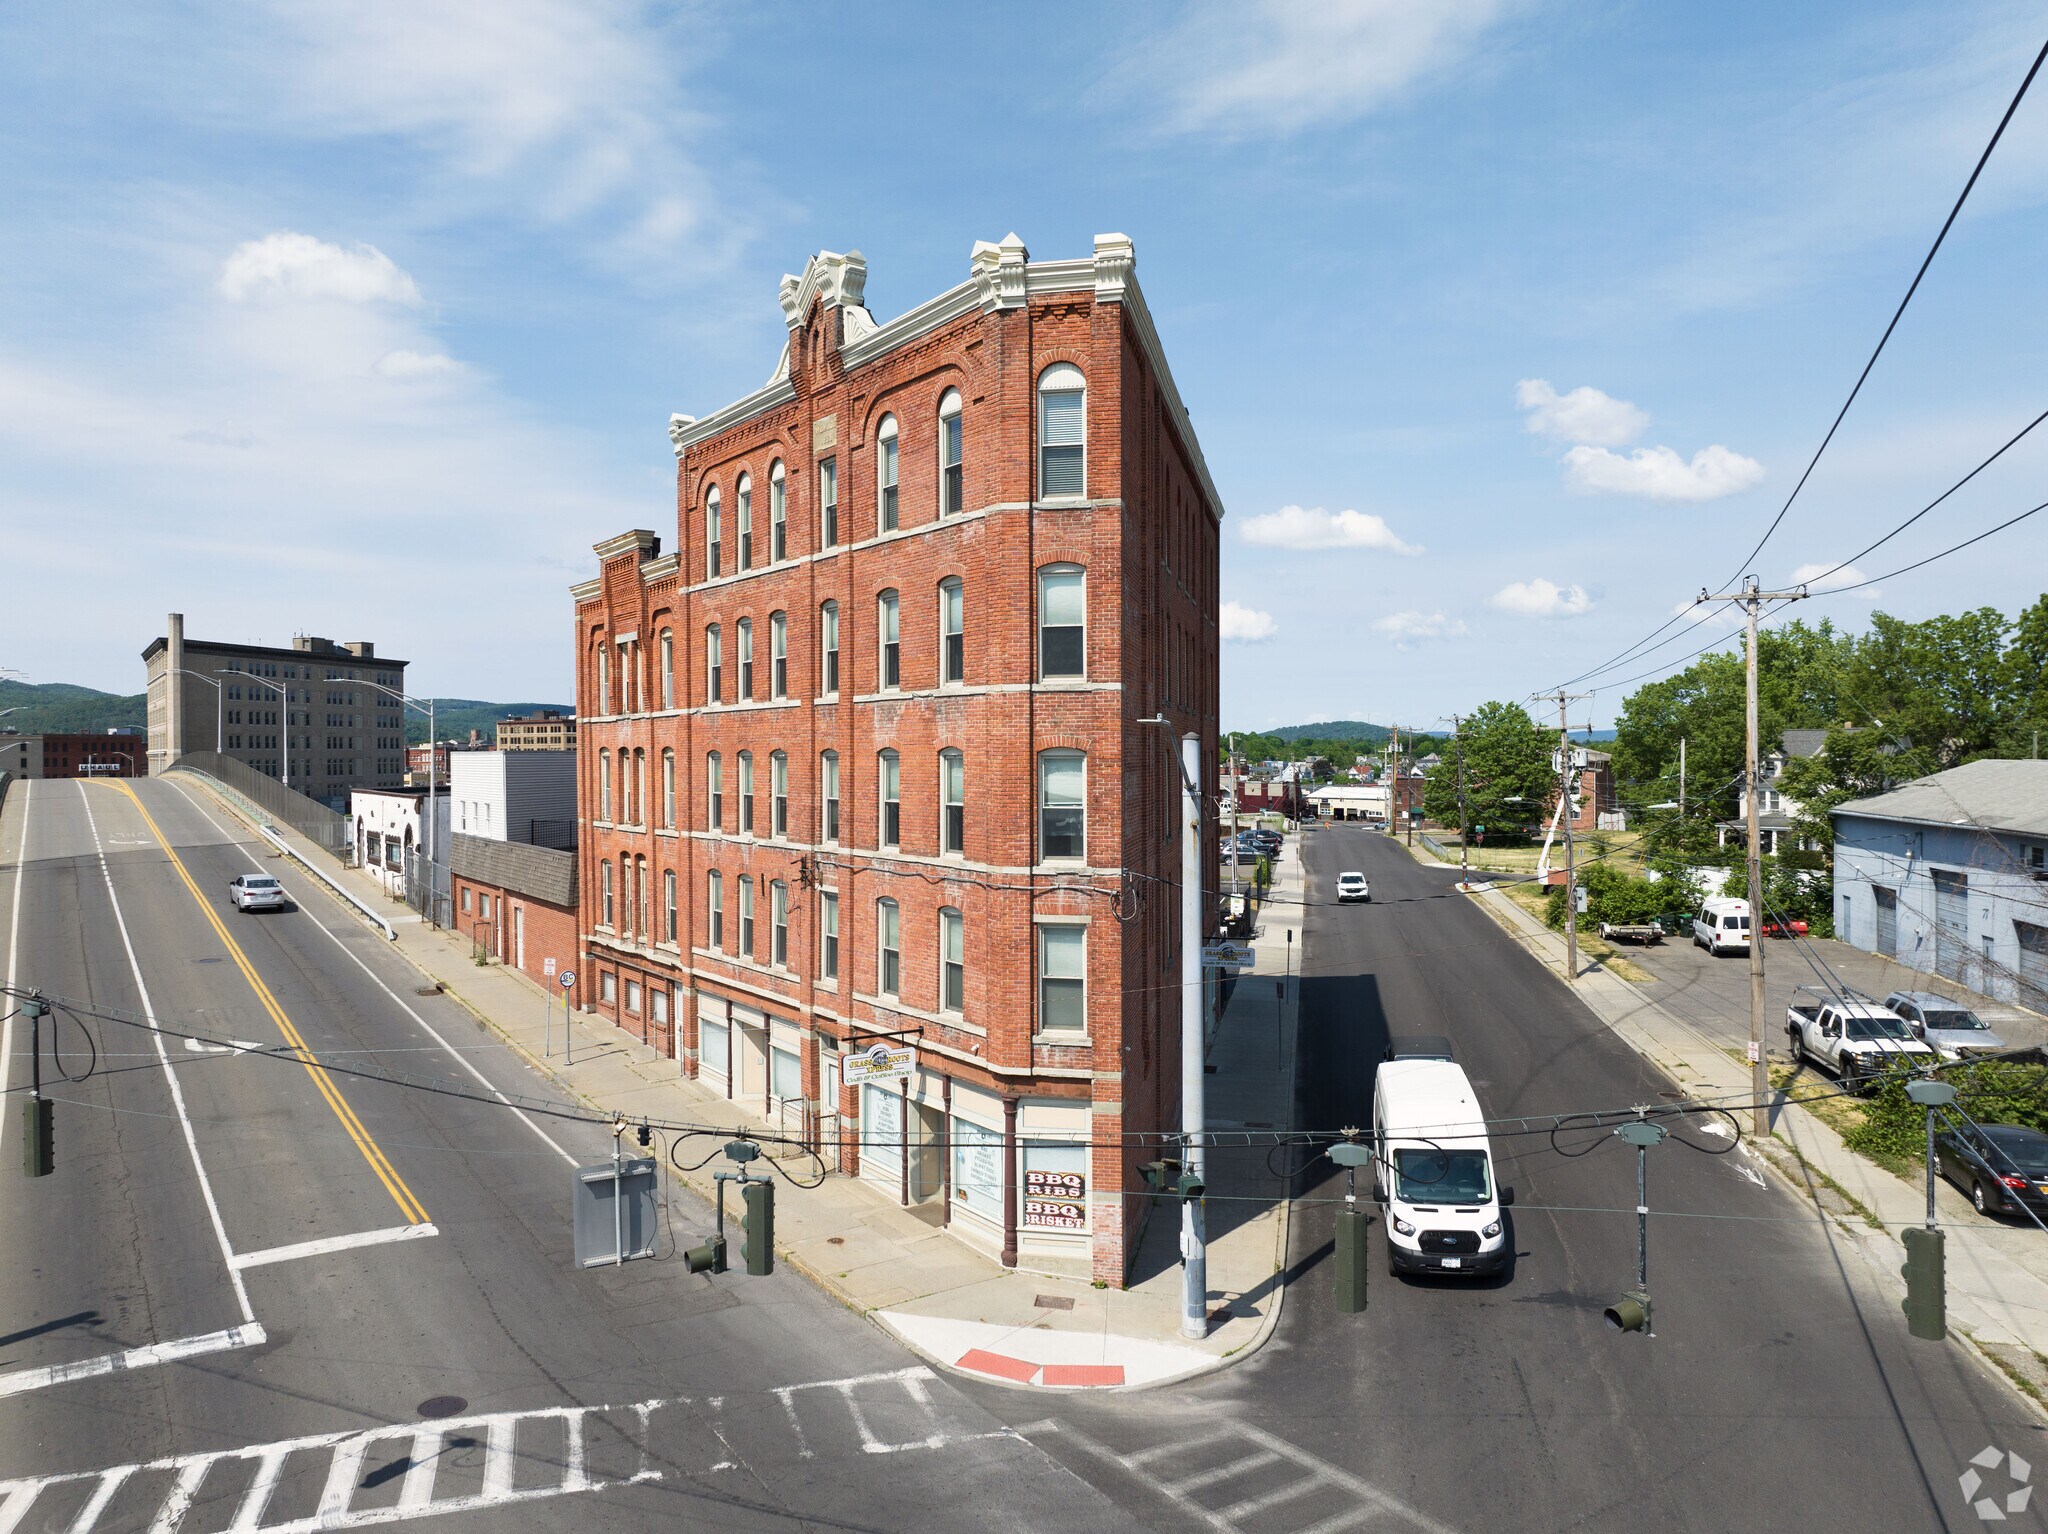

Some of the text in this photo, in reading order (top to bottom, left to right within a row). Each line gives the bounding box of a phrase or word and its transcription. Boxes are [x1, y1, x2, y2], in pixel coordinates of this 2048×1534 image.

[849, 1054, 910, 1068] GRASS ROOTS
[866, 1064, 893, 1073] XPRESS
[1028, 1173, 1081, 1187] BBQ
[1028, 1185, 1080, 1197] RIBS
[1026, 1202, 1078, 1218] BBQ
